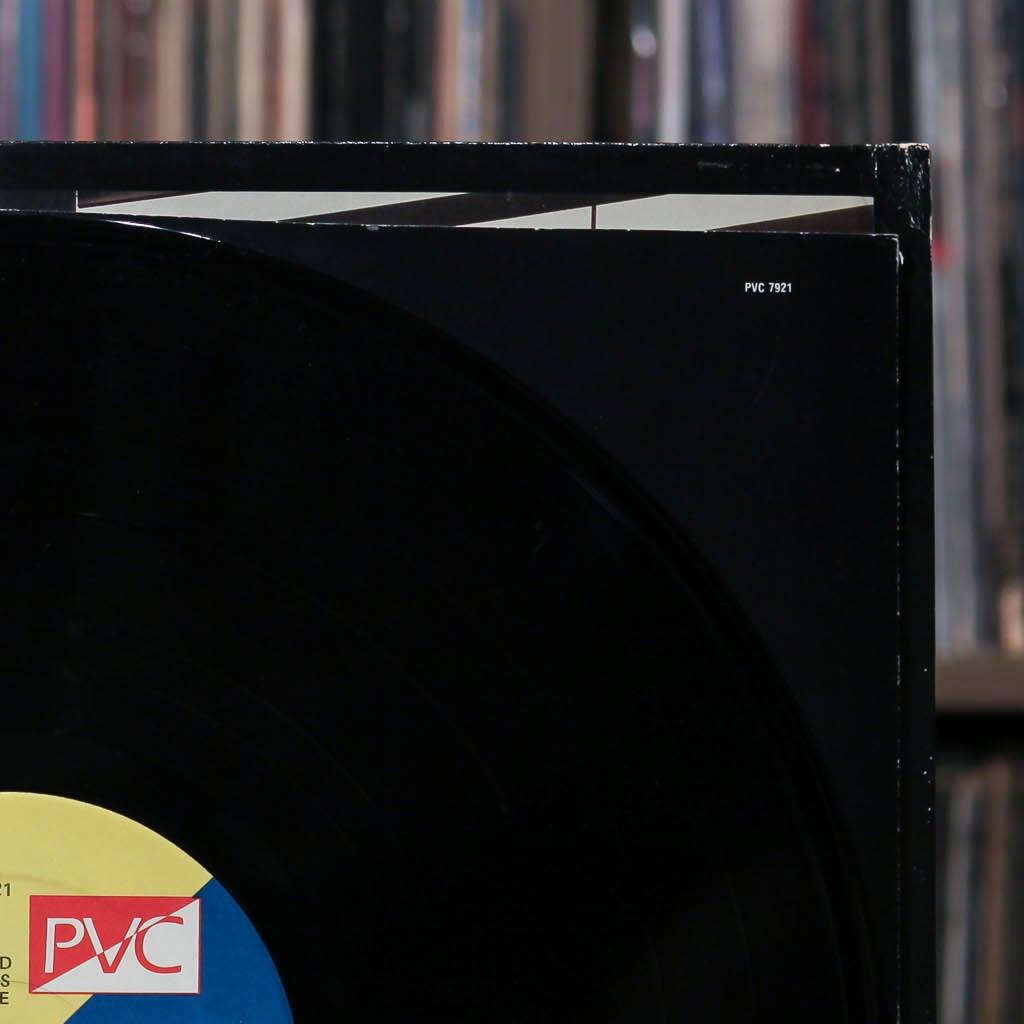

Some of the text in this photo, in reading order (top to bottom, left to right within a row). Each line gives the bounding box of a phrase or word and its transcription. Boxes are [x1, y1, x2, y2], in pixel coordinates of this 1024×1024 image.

[744, 282, 792, 293] PVC 7921
[44, 915, 184, 974] PVC
